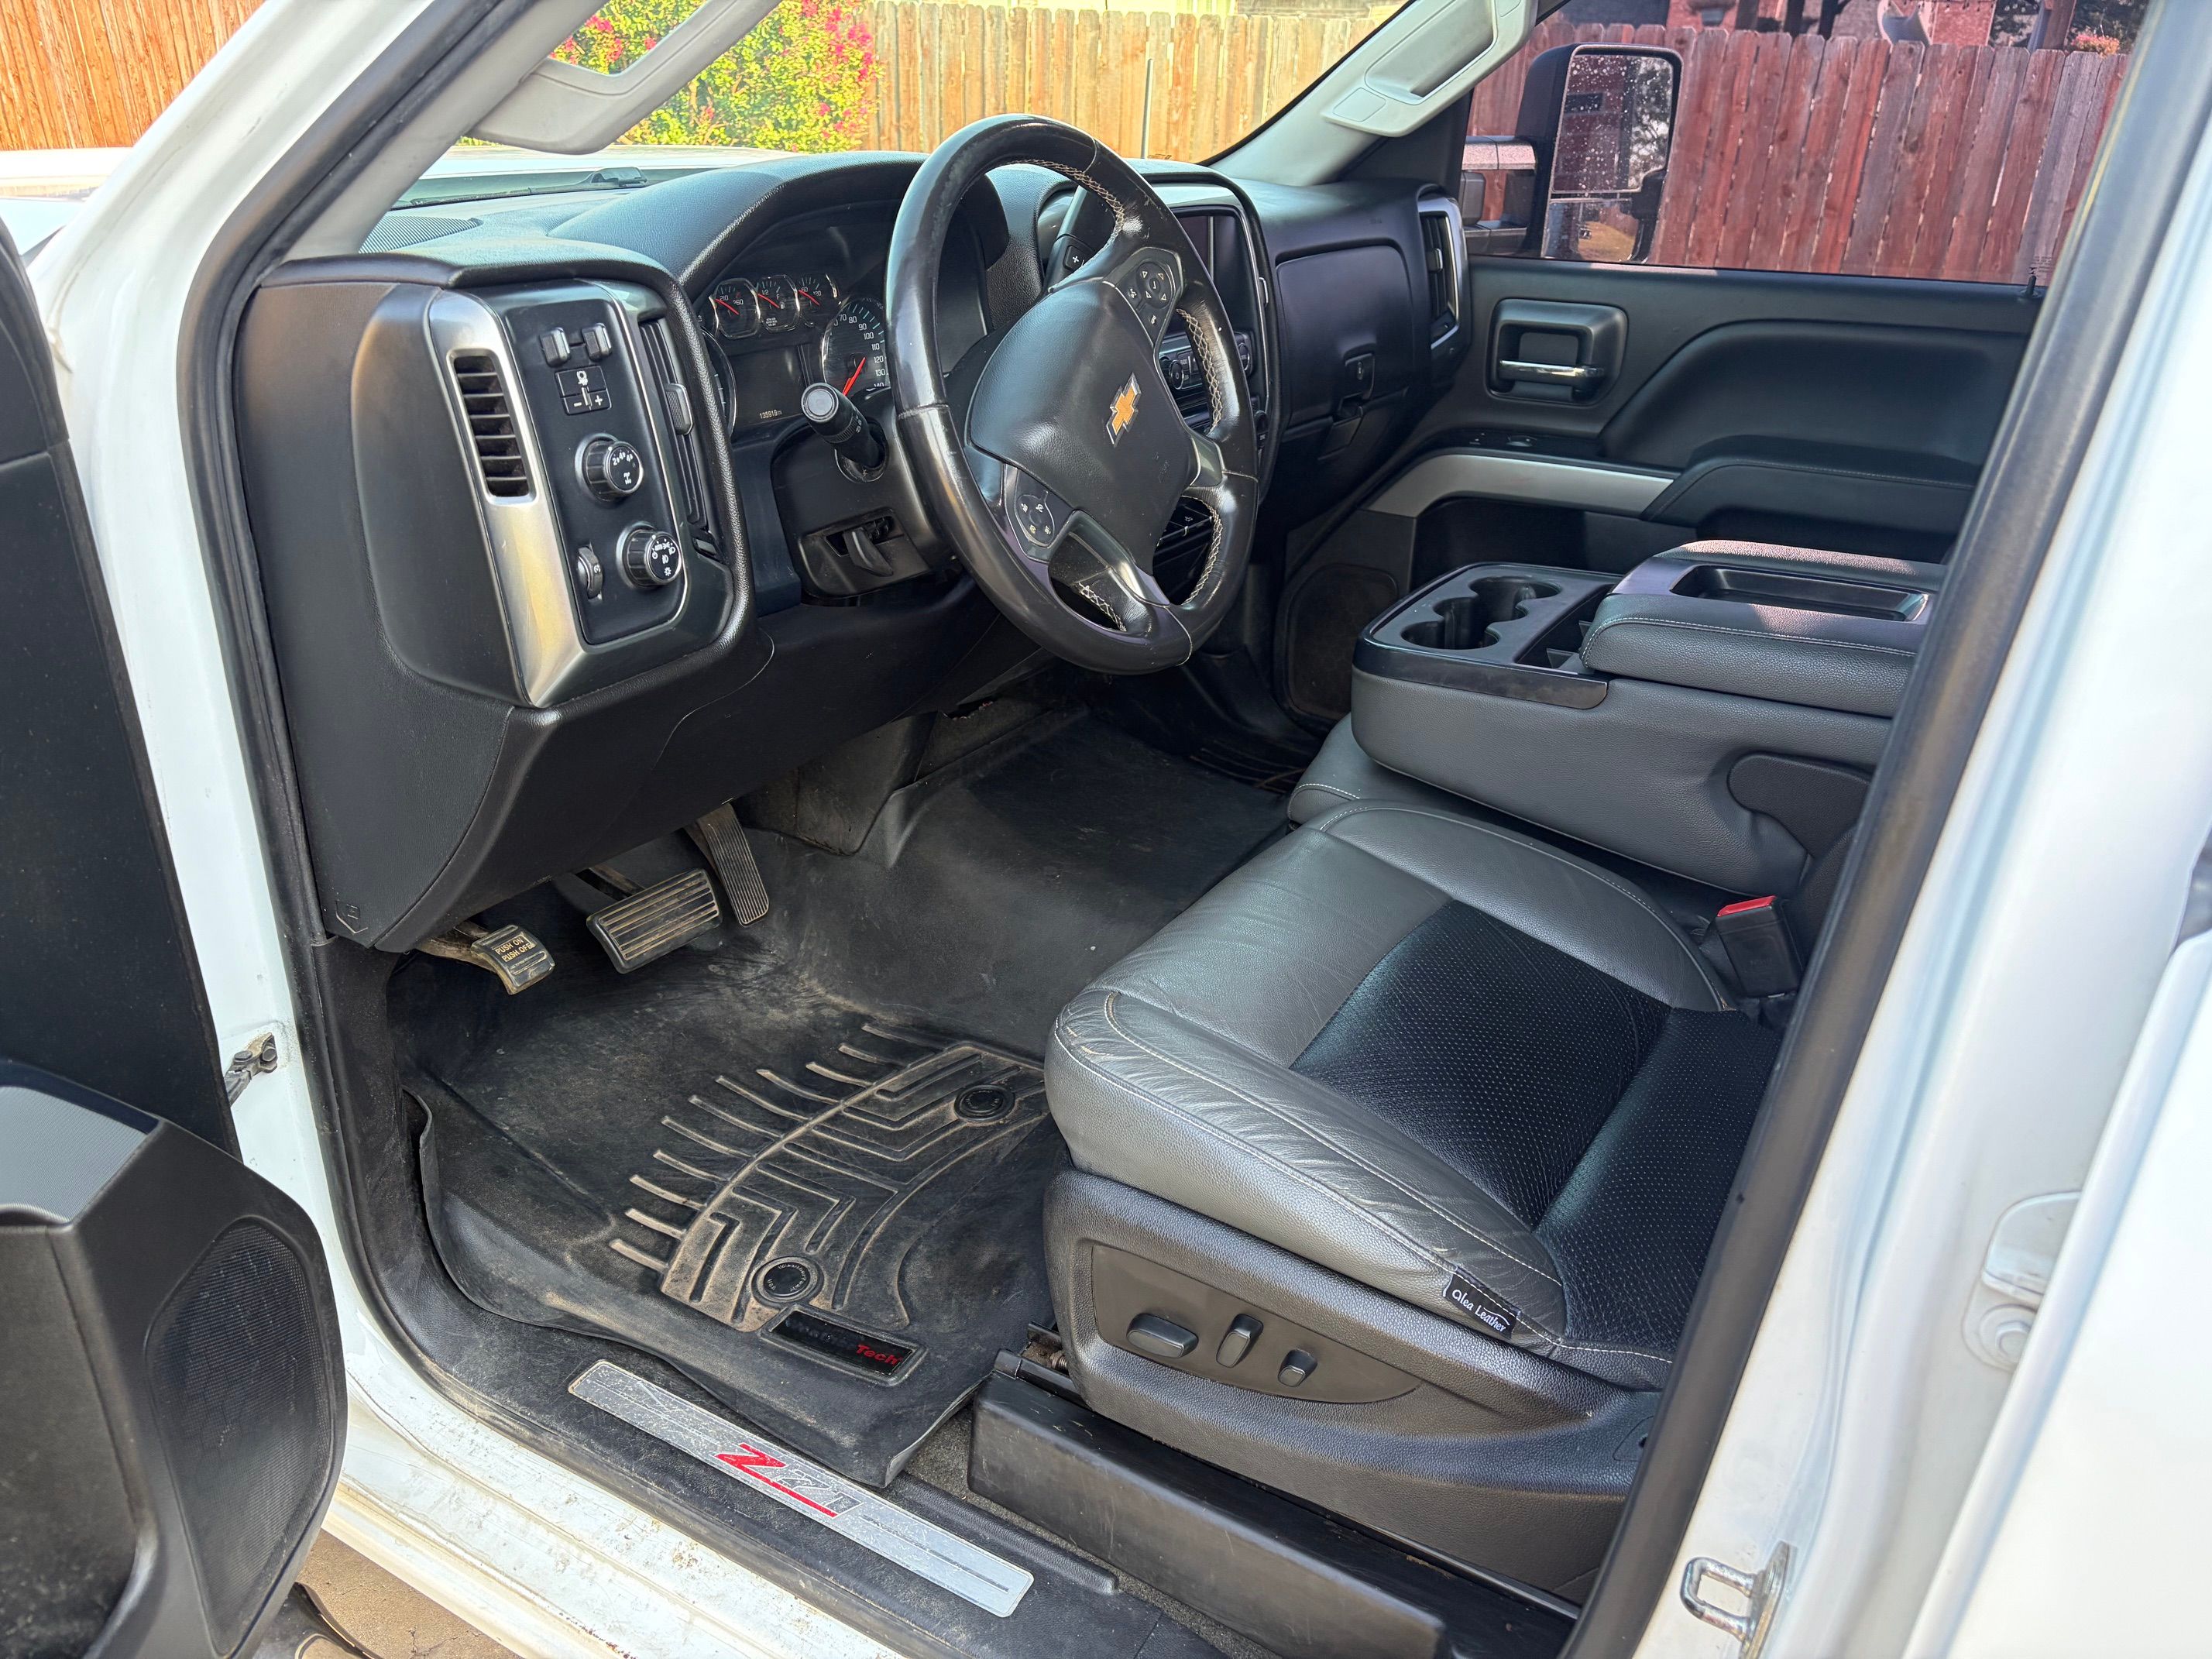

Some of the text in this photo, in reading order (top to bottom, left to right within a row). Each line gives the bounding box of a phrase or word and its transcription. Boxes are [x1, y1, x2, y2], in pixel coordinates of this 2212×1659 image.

[858, 322, 867, 331] 90
[863, 331, 874, 340] 100
[495, 937, 524, 955] PUSH ON
[501, 943, 534, 963] PUSH OFF
[1475, 1304, 1506, 1332] Leather
[856, 1344, 898, 1365] Tech
[713, 1442, 864, 1518] Z71
